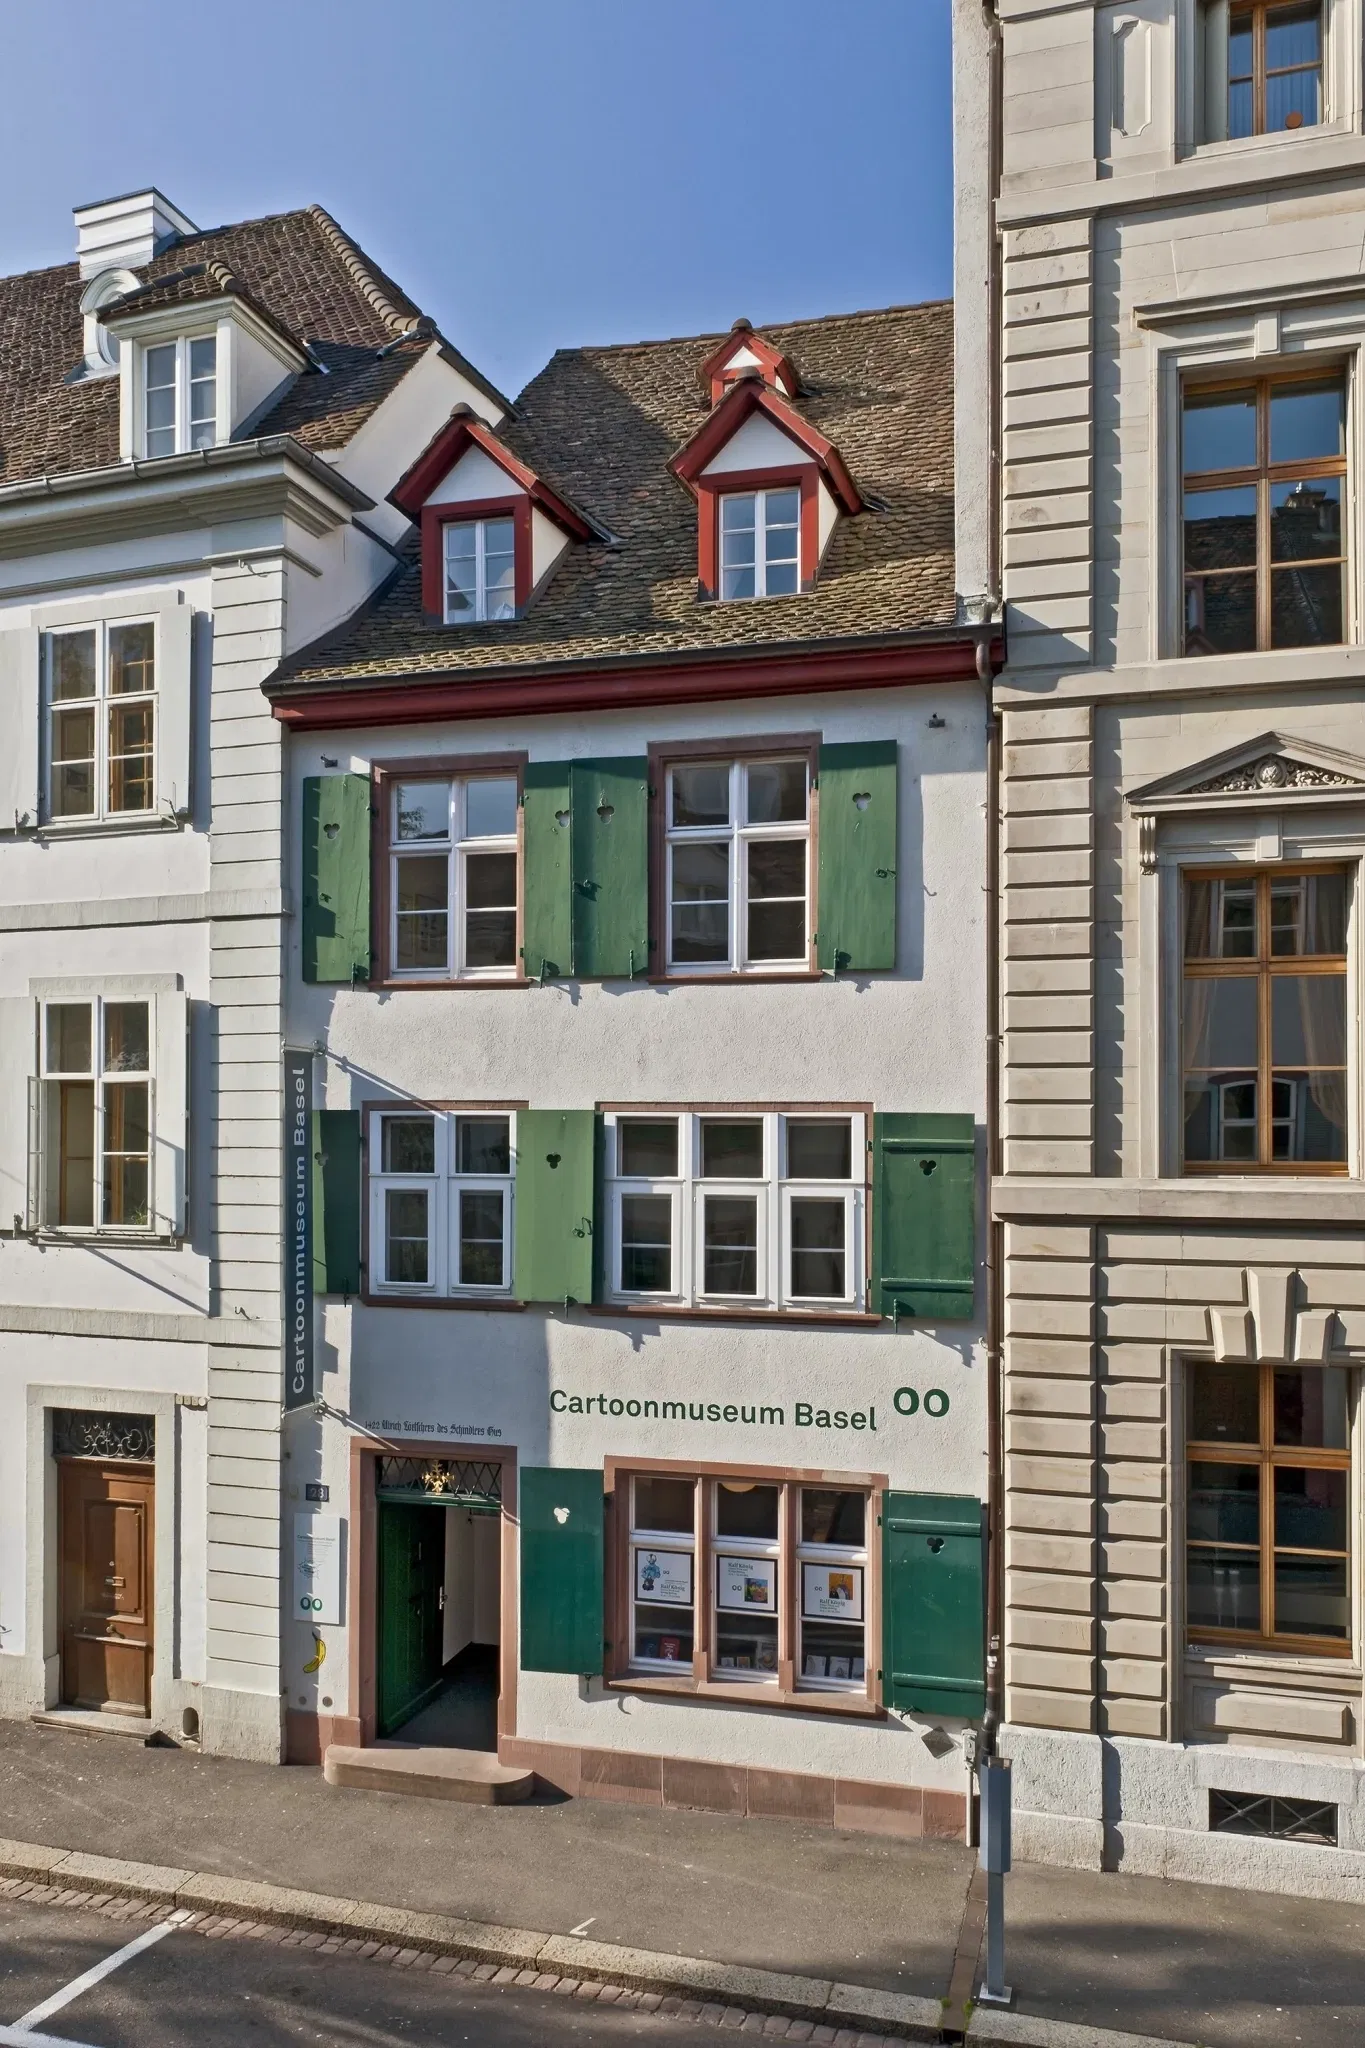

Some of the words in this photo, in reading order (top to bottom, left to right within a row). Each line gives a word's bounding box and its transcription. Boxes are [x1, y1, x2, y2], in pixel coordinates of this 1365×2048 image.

[292, 1067, 305, 1147] Basel
[292, 1155, 305, 1395] Cartoonmuseum
[550, 1389, 785, 1425] Cartoonmuseum
[795, 1403, 877, 1431] Basel
